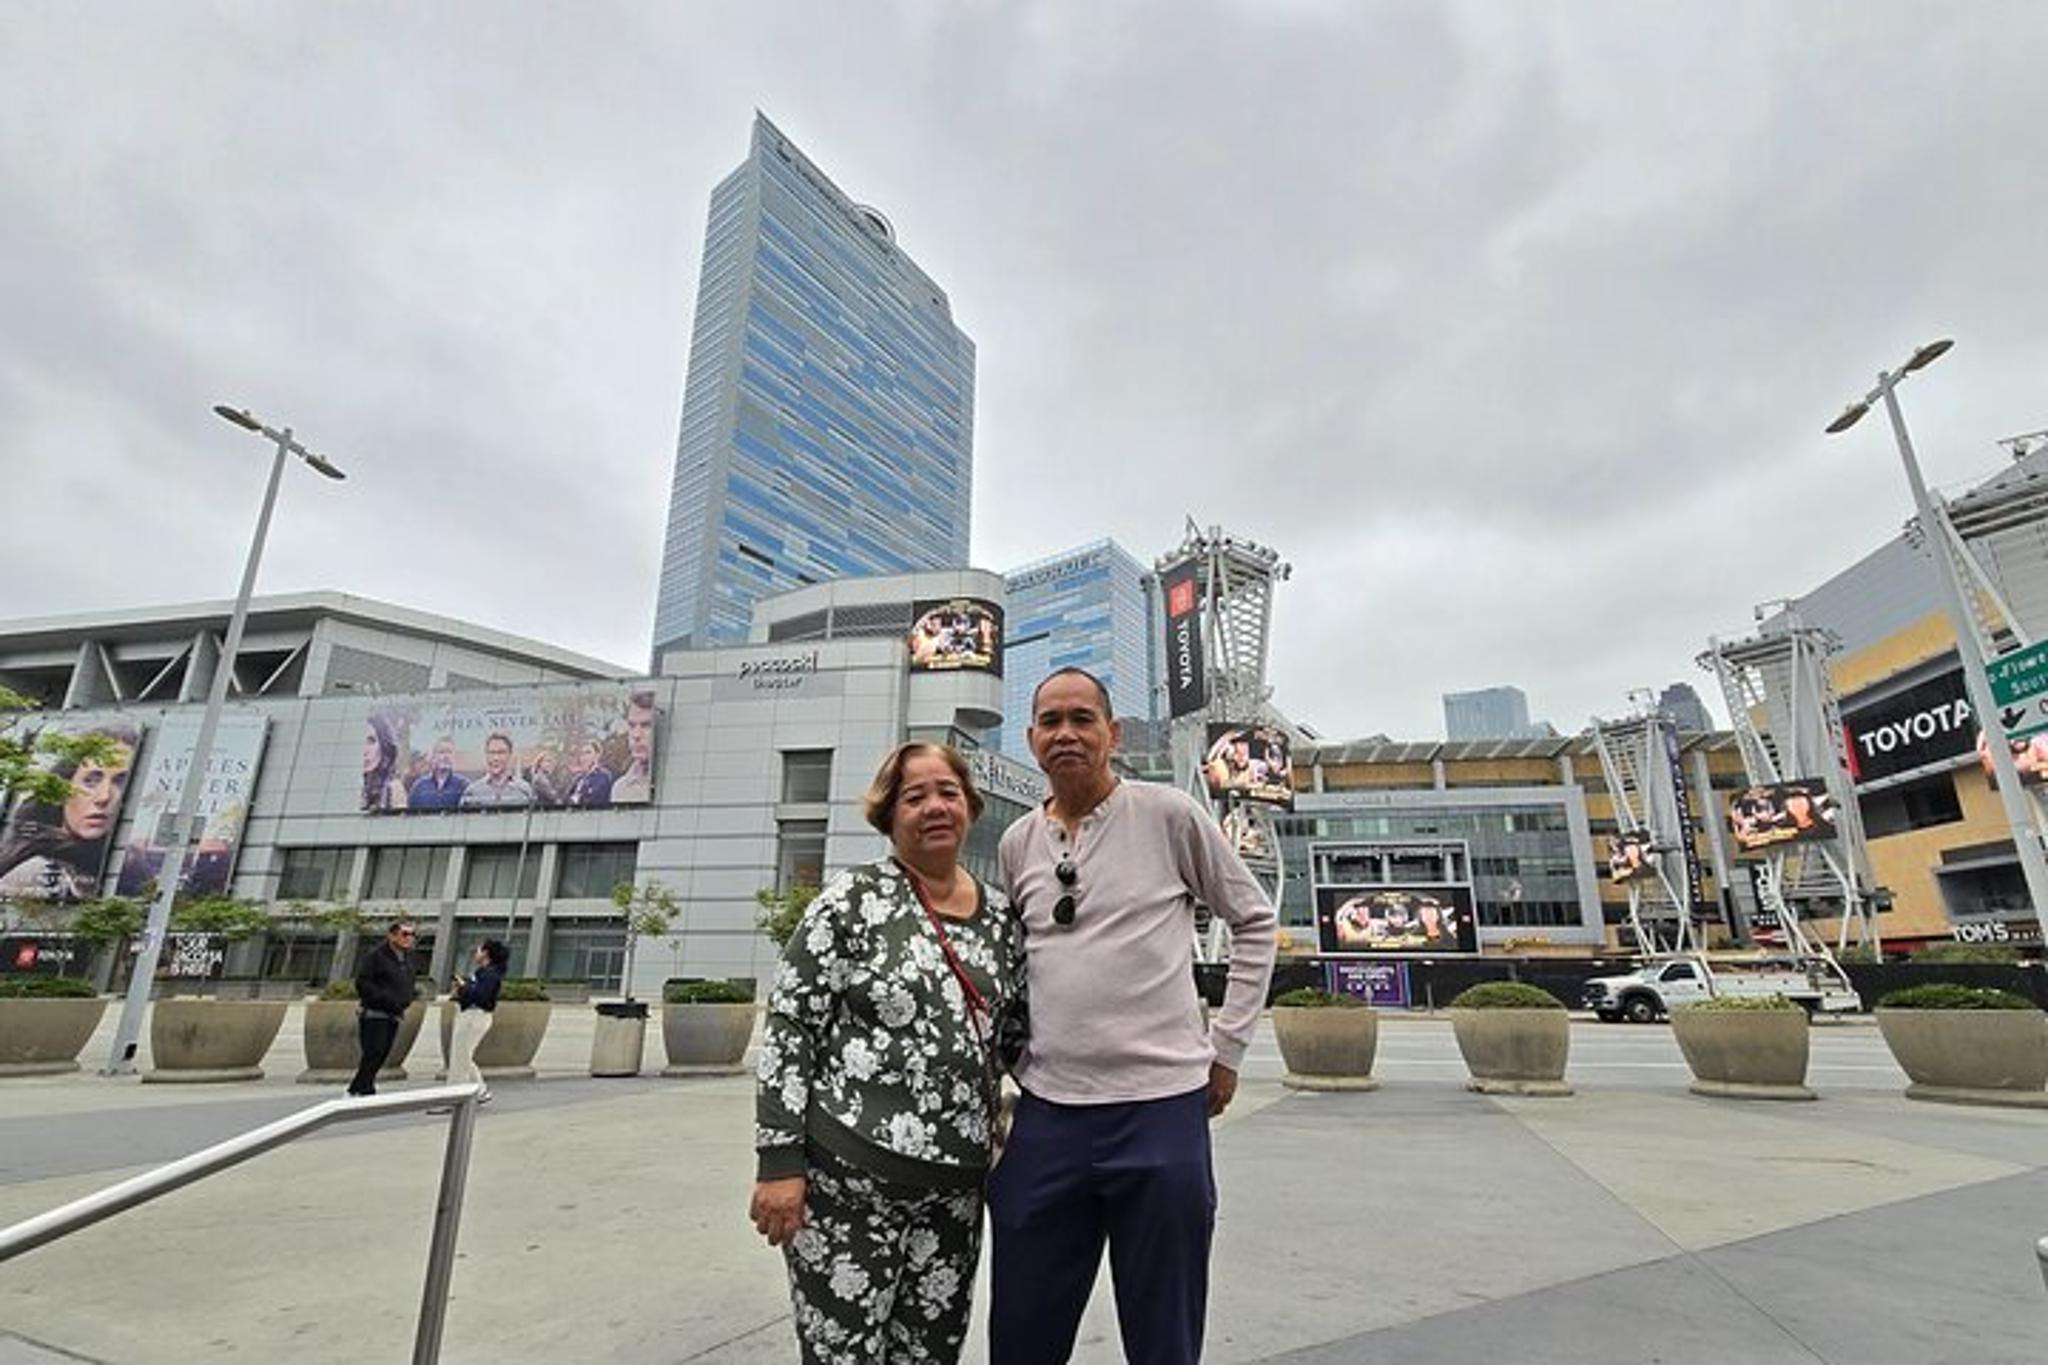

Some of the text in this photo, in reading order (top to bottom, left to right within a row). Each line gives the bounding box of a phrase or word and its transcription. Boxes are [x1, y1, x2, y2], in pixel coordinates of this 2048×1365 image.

[1177, 618, 1193, 690] TOYOTA
[1859, 699, 1972, 757] TOYOTA
[157, 757, 248, 773] APLES
[1952, 919, 2009, 942] TOM'S
